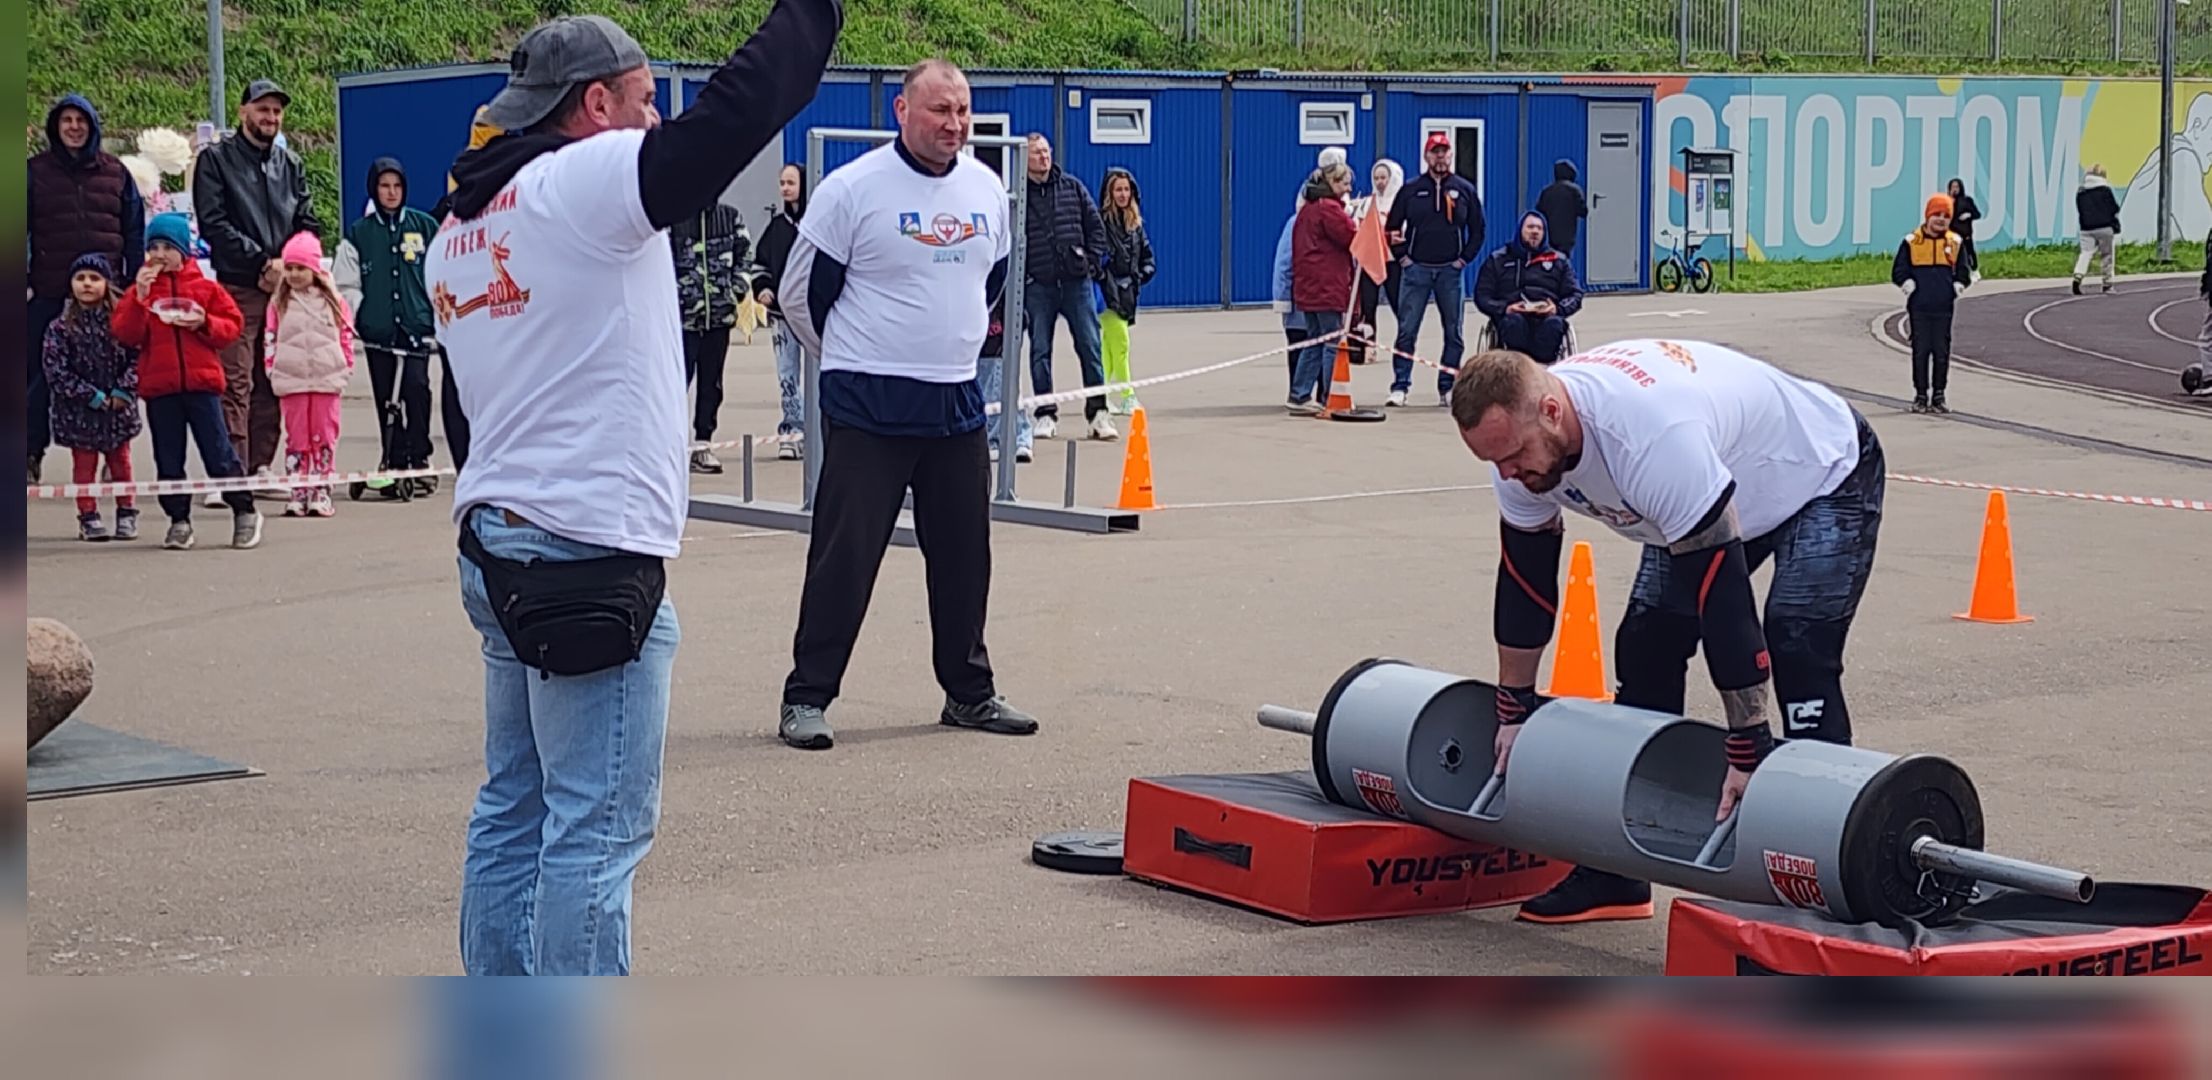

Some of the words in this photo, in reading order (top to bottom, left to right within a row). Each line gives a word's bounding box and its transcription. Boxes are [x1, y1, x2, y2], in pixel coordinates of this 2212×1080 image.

[1654, 94, 2083, 250] СПОРТОМ
[1366, 847, 1547, 886] YOUSTEEL
[1765, 852, 1817, 876] ПОБЕДА!
[2002, 935, 2203, 976] STEEL
